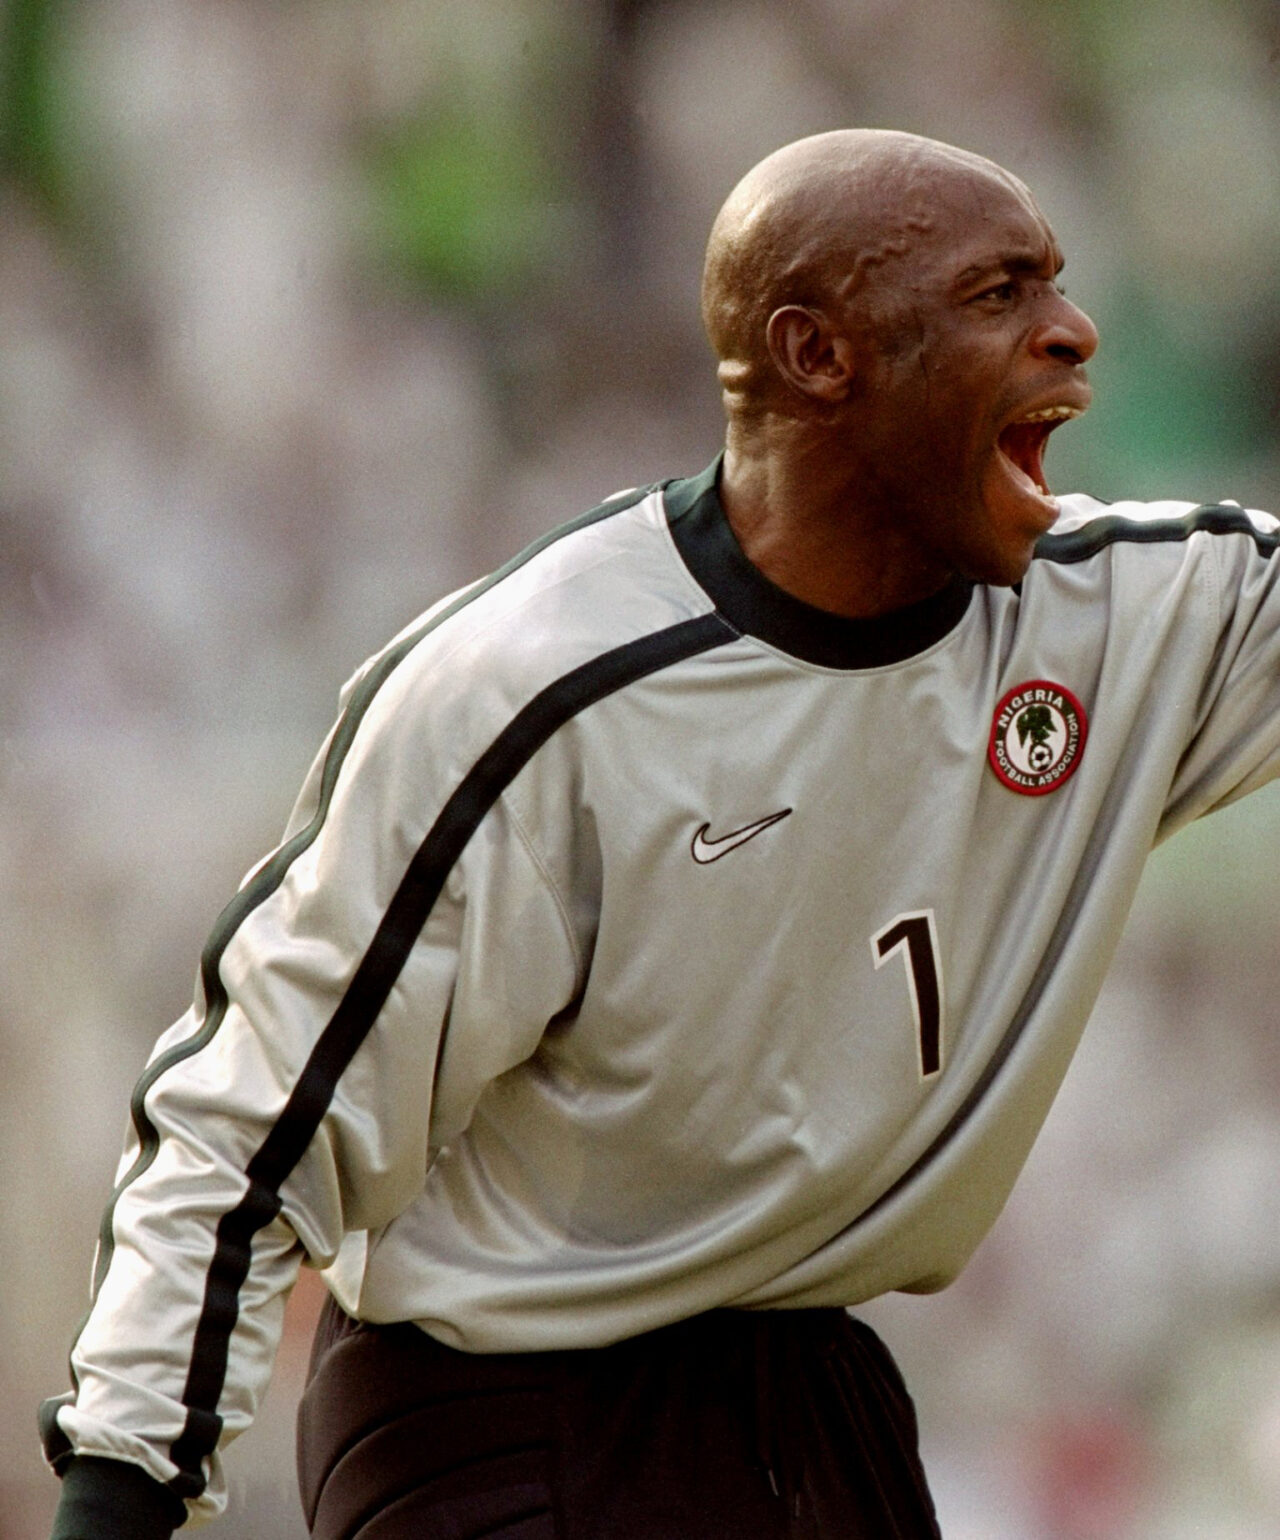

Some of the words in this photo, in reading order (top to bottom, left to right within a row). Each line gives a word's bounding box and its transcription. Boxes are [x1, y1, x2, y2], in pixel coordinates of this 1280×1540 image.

[998, 689, 1063, 728] NIGERIA
[995, 740, 1035, 786] FOOTBALL
[1038, 713, 1079, 786] ASSOCIATION
[872, 910, 943, 1081] 1
